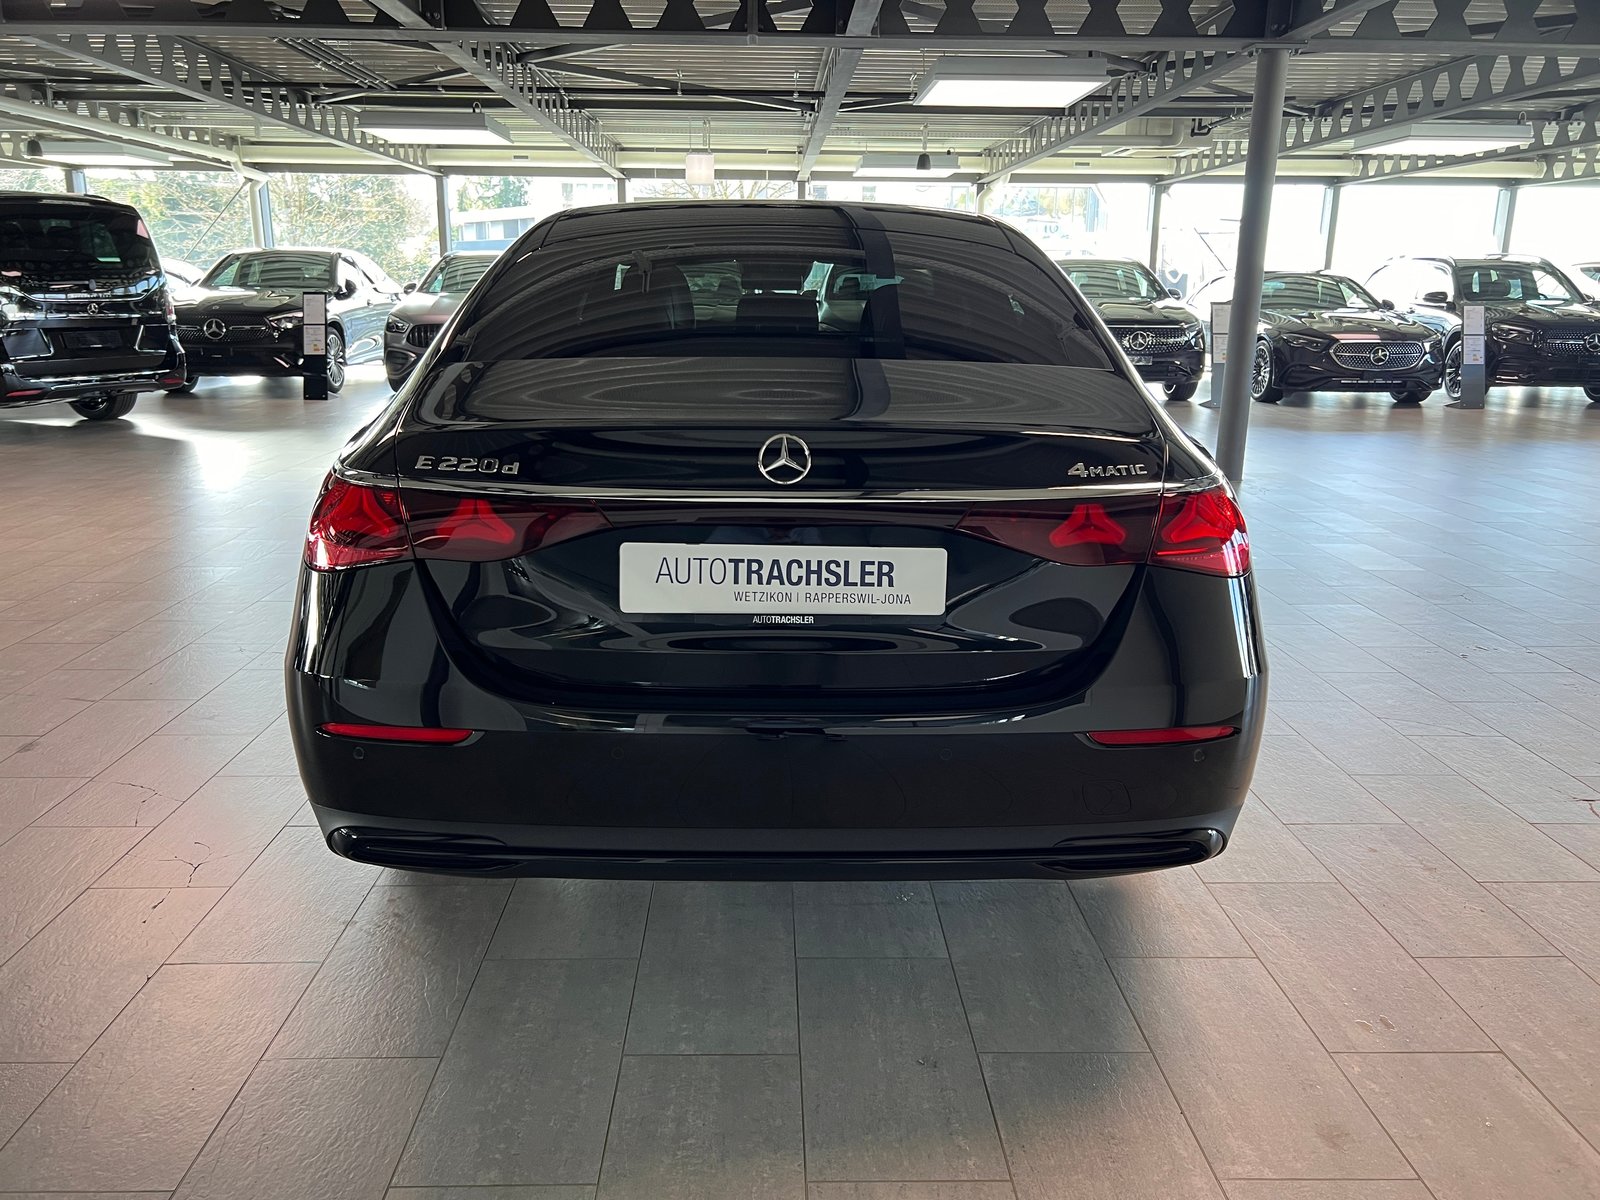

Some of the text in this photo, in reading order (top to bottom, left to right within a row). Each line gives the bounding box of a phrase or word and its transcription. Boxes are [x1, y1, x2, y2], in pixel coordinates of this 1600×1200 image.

[1067, 462, 1148, 478] 4MATIC
[655, 556, 895, 588] AUTOTRACHSLER
[733, 591, 792, 603] WETZIKON
[804, 592, 912, 605] RAPPERSWIL-JONA
[752, 615, 815, 625] AUTOTRACHSLER
